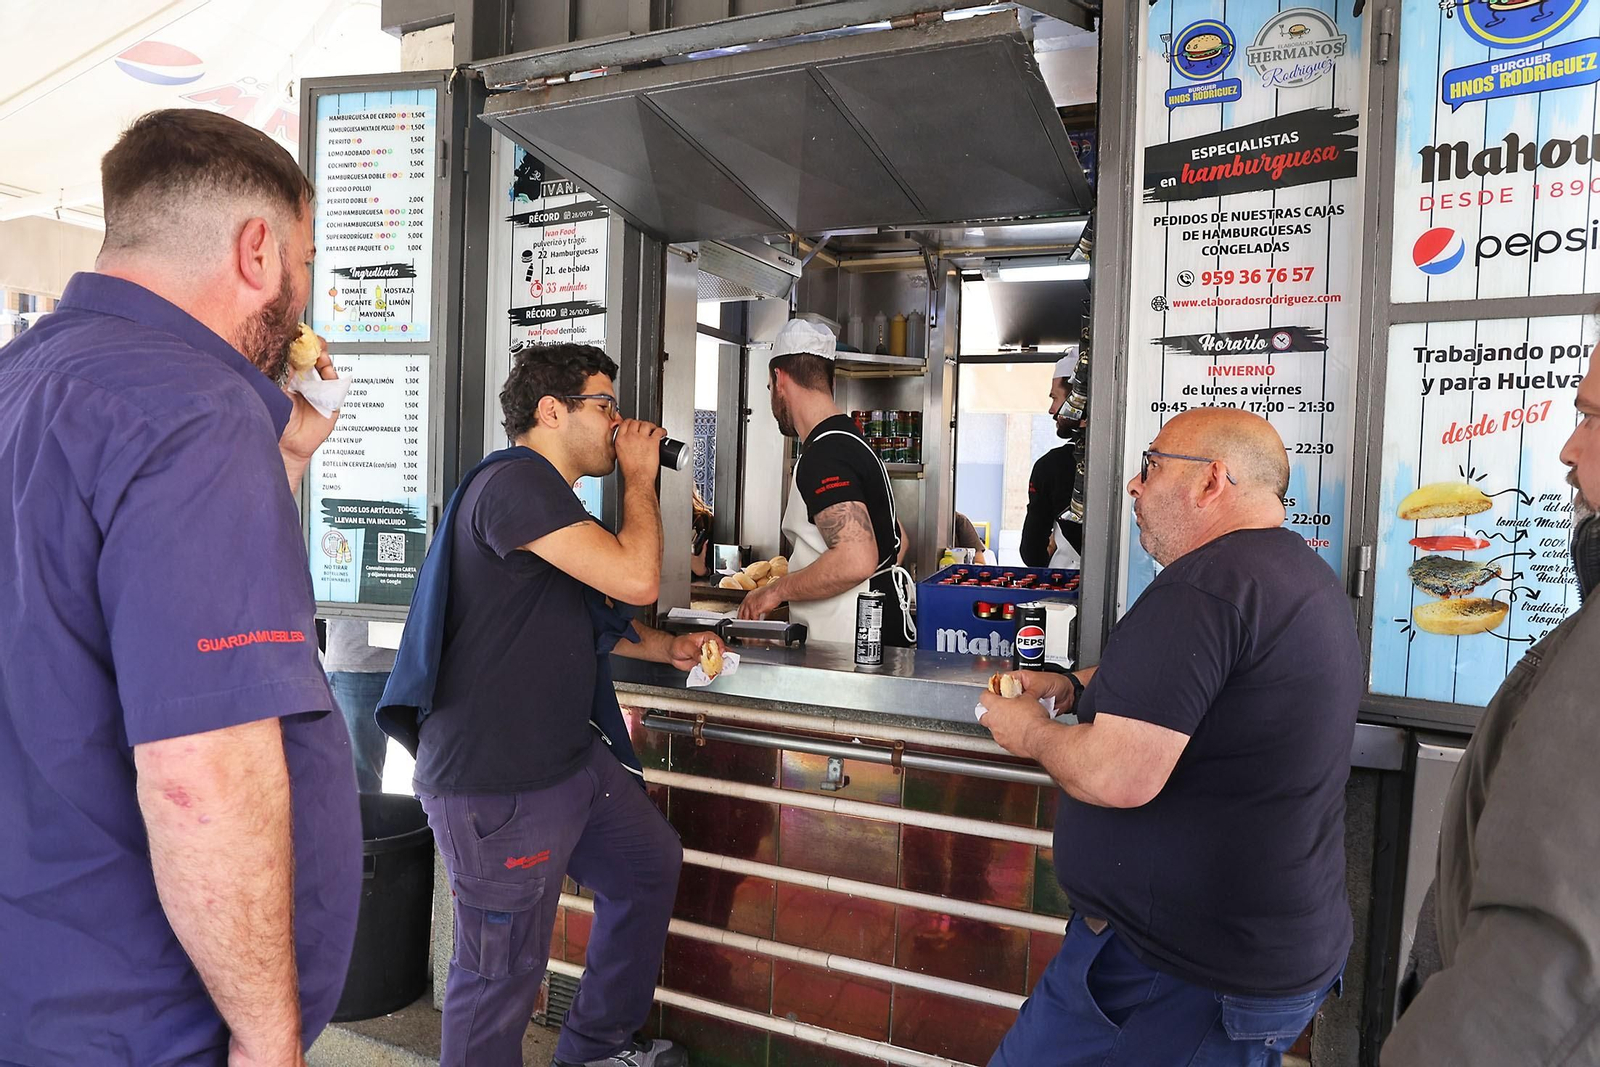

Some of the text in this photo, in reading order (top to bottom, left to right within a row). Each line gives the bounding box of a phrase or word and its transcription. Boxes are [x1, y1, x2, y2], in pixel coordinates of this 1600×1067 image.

[1250, 42, 1342, 63] HERMANOS
[1491, 53, 1551, 74] BURGUER
[1450, 52, 1597, 99] HNOS RODRIGUEZ
[1189, 84, 1216, 93] BURGUER
[1169, 94, 1190, 104] HNOS
[1192, 131, 1299, 160] ESPECIALISTAS
[1160, 145, 1339, 188] en hamburguesa
[543, 182, 573, 196] IVAN
[1420, 188, 1514, 211] DESDE
[529, 212, 559, 223] RÉCORD
[1153, 205, 1344, 227] PEDIDOS DE NUESTRAS CAJAS
[326, 232, 373, 240] SUPERRODRÍGUEZ
[1183, 224, 1311, 241] DE HAMBURGUESAS
[533, 238, 562, 249] pulverizó
[1202, 242, 1289, 256] CONGELADAS
[1475, 220, 1598, 267] pepsi
[538, 248, 598, 259] 22 Hamburguesas
[350, 267, 398, 280] Ingredientes
[568, 265, 590, 273] bebida
[1201, 266, 1314, 285] 959 36 76 57
[546, 282, 587, 293] 33 minutos
[1173, 293, 1341, 308] www.elaboradosrodriguez.com
[526, 306, 556, 319] RÉCORD
[559, 326, 587, 334] demolió:
[1198, 333, 1268, 351] Horario
[1414, 343, 1593, 366] Trabajando por
[1208, 366, 1275, 376] INVIERNO
[1182, 384, 1301, 395] de lunes a viernes
[1421, 371, 1583, 396] y para Huelva
[1151, 402, 1334, 412] 09:45 17:00 21:30
[1442, 400, 1552, 444] desde 1967
[1295, 444, 1333, 454] 22:30
[1539, 494, 1561, 502] pan
[370, 506, 403, 514] ARTÍCULOS
[1543, 502, 1560, 512] del
[1292, 514, 1330, 525] 22:00
[1496, 517, 1531, 527] tomate
[1539, 538, 1566, 547] 100%
[1542, 549, 1570, 558] cerdo
[1530, 564, 1560, 572] amor
[1536, 572, 1575, 584] Huelva
[1521, 601, 1568, 613] tradición
[197, 631, 305, 652] GUARDAMUEBLES
[937, 628, 1014, 657] Mah
